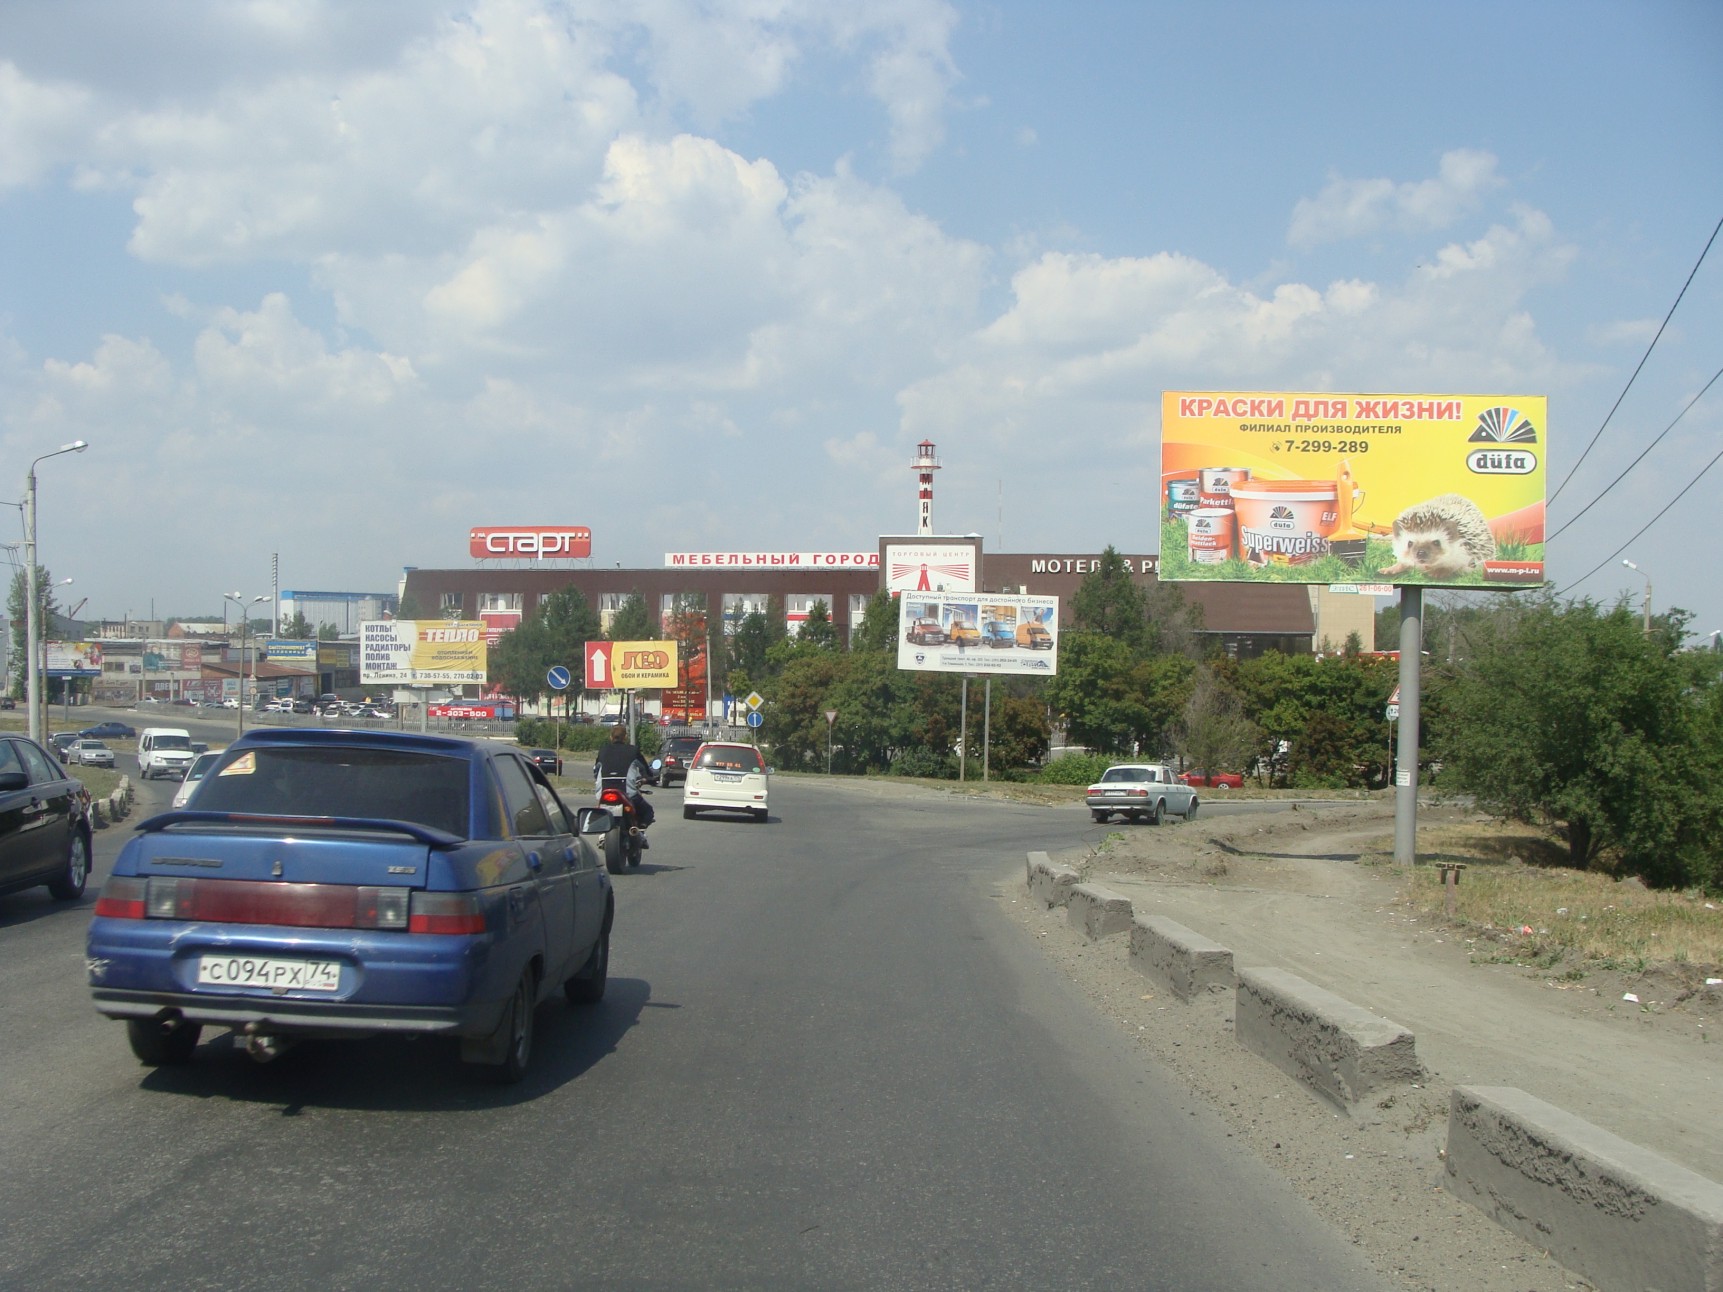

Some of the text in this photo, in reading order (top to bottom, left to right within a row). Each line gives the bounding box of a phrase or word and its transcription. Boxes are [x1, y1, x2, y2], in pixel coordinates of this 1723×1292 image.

[1180, 398, 1462, 421] КРАСКИ ДЛЯ ЖИЗНИ!
[1239, 424, 1402, 435] ФИЛИАЛ ПРОИЗВОДИТЕЛЯ
[1285, 440, 1369, 453] 7-299-289
[1476, 454, 1526, 470] düfa
[1322, 512, 1337, 521] ELF
[1241, 526, 1329, 554] Superweiss
[672, 553, 880, 566] МЕБЕЛЬНЫЙ ГОРОД
[906, 592, 942, 601] Доступный
[1027, 597, 1054, 605] бизнеса
[365, 634, 398, 642] НАСОСЫ
[425, 628, 480, 643] ТЕПЛО
[365, 643, 411, 652] РАДИАТОРЫ
[365, 653, 390, 661] ПОЛИВ
[365, 662, 397, 670] МОНТАЖ
[309, 961, 332, 980] 74
